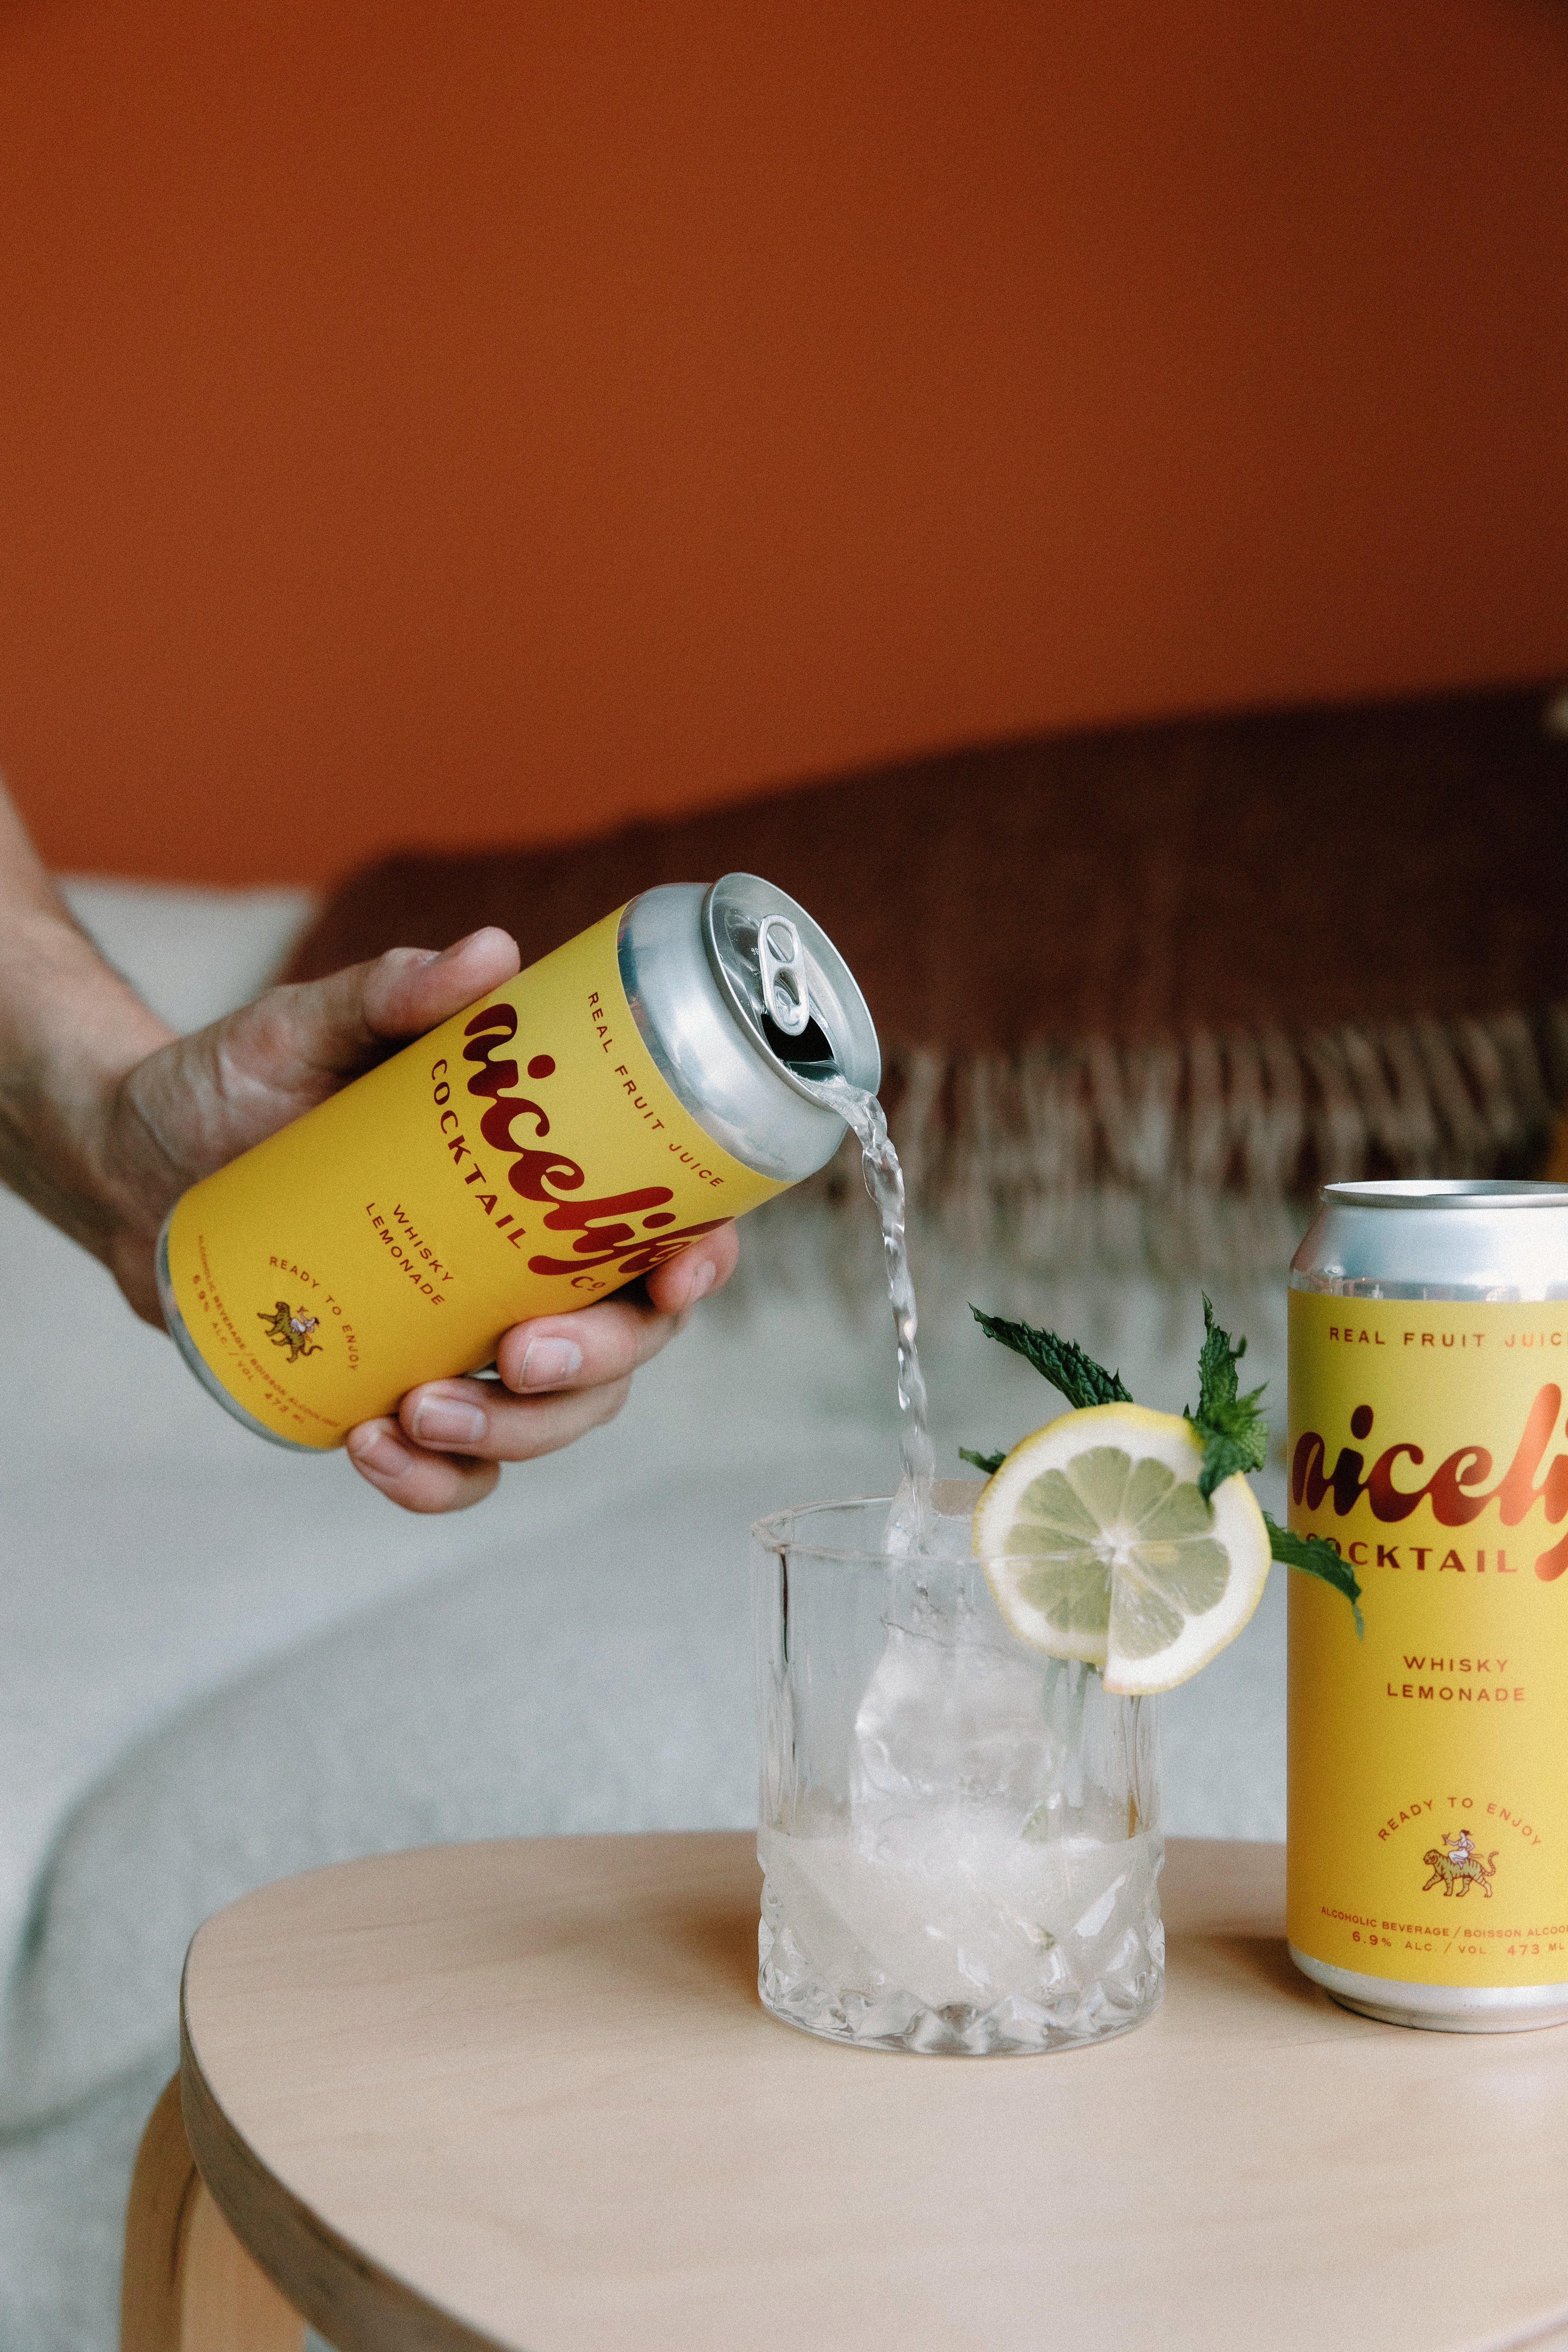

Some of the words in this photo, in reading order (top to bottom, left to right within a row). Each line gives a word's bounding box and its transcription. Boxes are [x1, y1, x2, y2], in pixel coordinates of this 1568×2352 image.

[588, 992, 613, 1053] REAL
[615, 1065, 665, 1130] FRUIT
[669, 1142, 725, 1187] JUICE
[431, 1059, 527, 1249] COCKTAIL
[366, 1202, 445, 1306] LEMONADE
[393, 1204, 454, 1281] WHISKY
[269, 1256, 320, 1289] READY
[325, 1295, 342, 1316] TO
[342, 1324, 359, 1371] ENJOY
[1329, 1326, 1385, 1345] REAL
[1403, 1332, 1486, 1348] FRUIT
[1505, 1332, 1568, 1348] JUIC
[1403, 1655, 1509, 1673] WHISKY
[1387, 1682, 1525, 1702] LEMONADE
[1378, 1799, 1433, 1841] READY
[1447, 1797, 1473, 1809] TO
[1486, 1802, 1541, 1846] ENJOY
[1321, 1906, 1377, 1928] ALCOHOLIC
[1352, 1931, 1392, 1948] 6.9%
[1507, 1944, 1540, 1956] 473
[1548, 1943, 1565, 1951] ML
